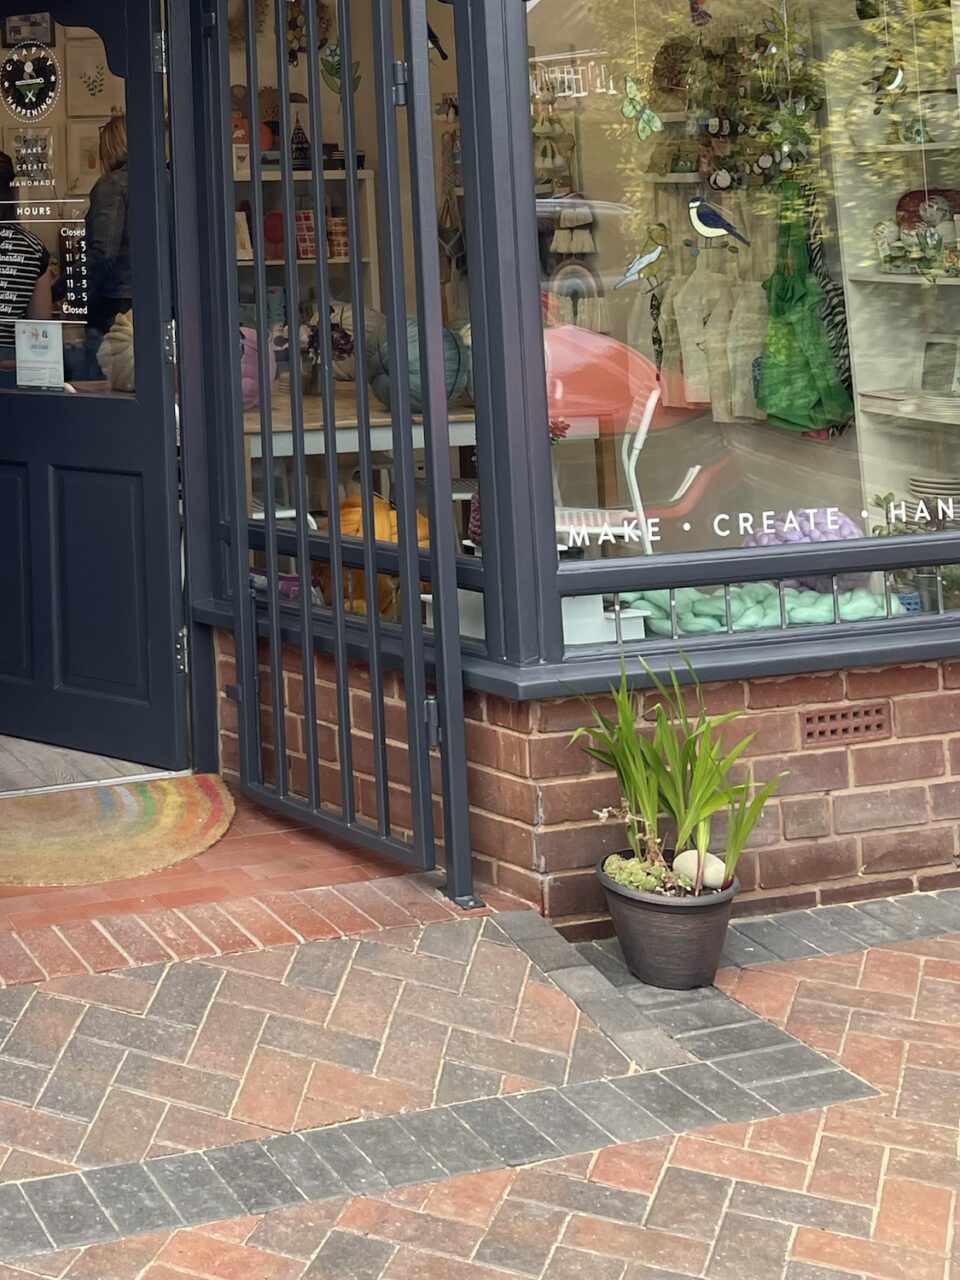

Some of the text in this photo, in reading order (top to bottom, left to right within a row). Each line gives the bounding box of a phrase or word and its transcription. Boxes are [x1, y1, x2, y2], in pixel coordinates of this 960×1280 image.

[5, 47, 53, 71] CRAFTY
[6, 90, 55, 118] HAPPENINGS
[20, 146, 42, 154] MAKE
[16, 163, 48, 171] CREATE
[9, 178, 56, 188] HANDMADE
[16, 207, 51, 216] HOURS
[60, 227, 86, 236] Closed
[62, 304, 88, 315] Closed
[568, 497, 954, 548] MAKE CREATE HAN
